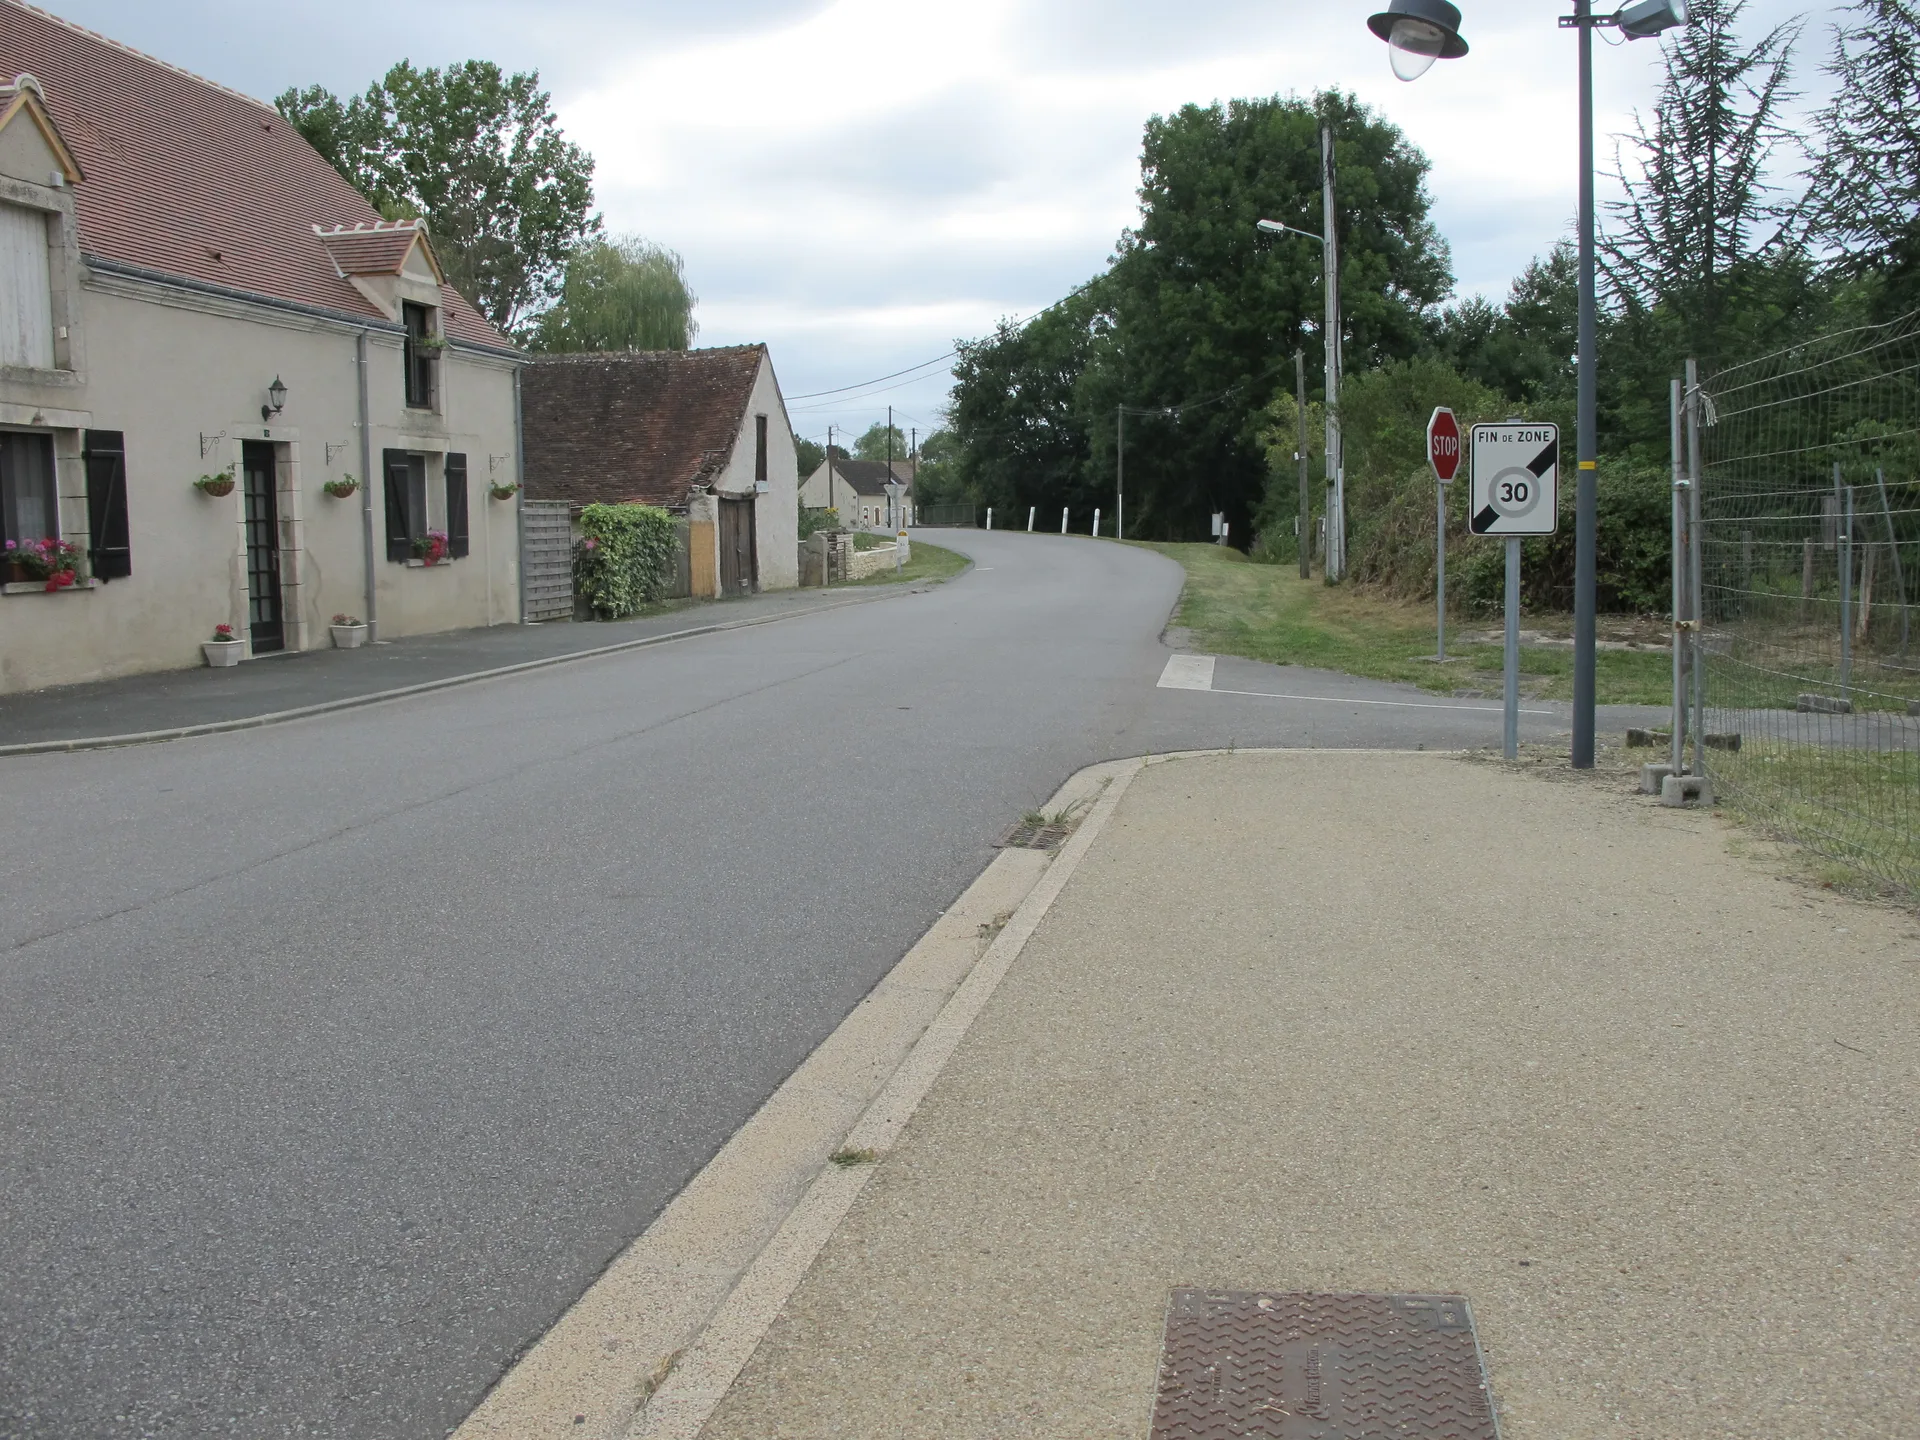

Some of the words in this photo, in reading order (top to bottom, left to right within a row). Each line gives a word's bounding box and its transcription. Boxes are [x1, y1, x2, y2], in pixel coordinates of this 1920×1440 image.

[1433, 435, 1458, 456] STOP
[1478, 431, 1497, 443] FIN
[1502, 434, 1513, 442] DE
[1517, 431, 1550, 442] ZONE
[1500, 482, 1528, 502] 30
